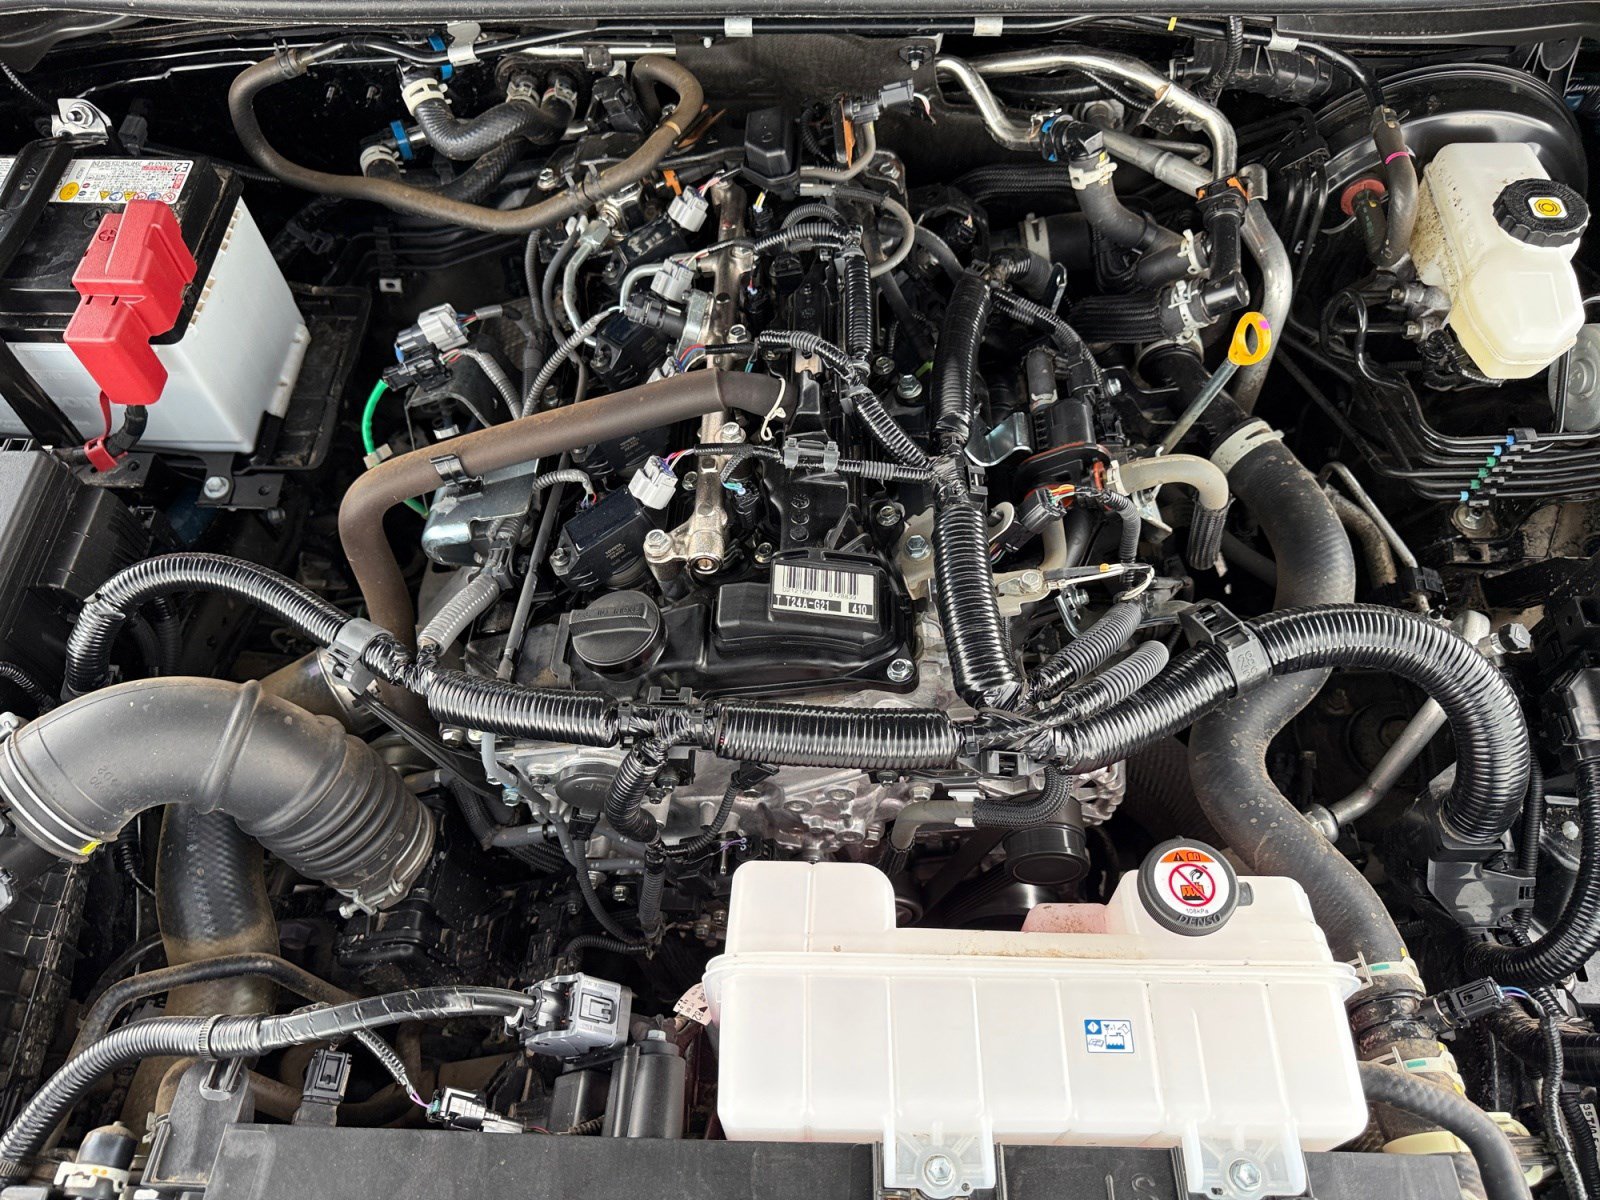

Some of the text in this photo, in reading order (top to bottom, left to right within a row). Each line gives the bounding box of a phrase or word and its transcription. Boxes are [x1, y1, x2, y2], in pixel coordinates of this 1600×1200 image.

[786, 596, 830, 612] T24A-G21
[852, 607, 867, 615] 410
[1176, 913, 1221, 927] DENSO
